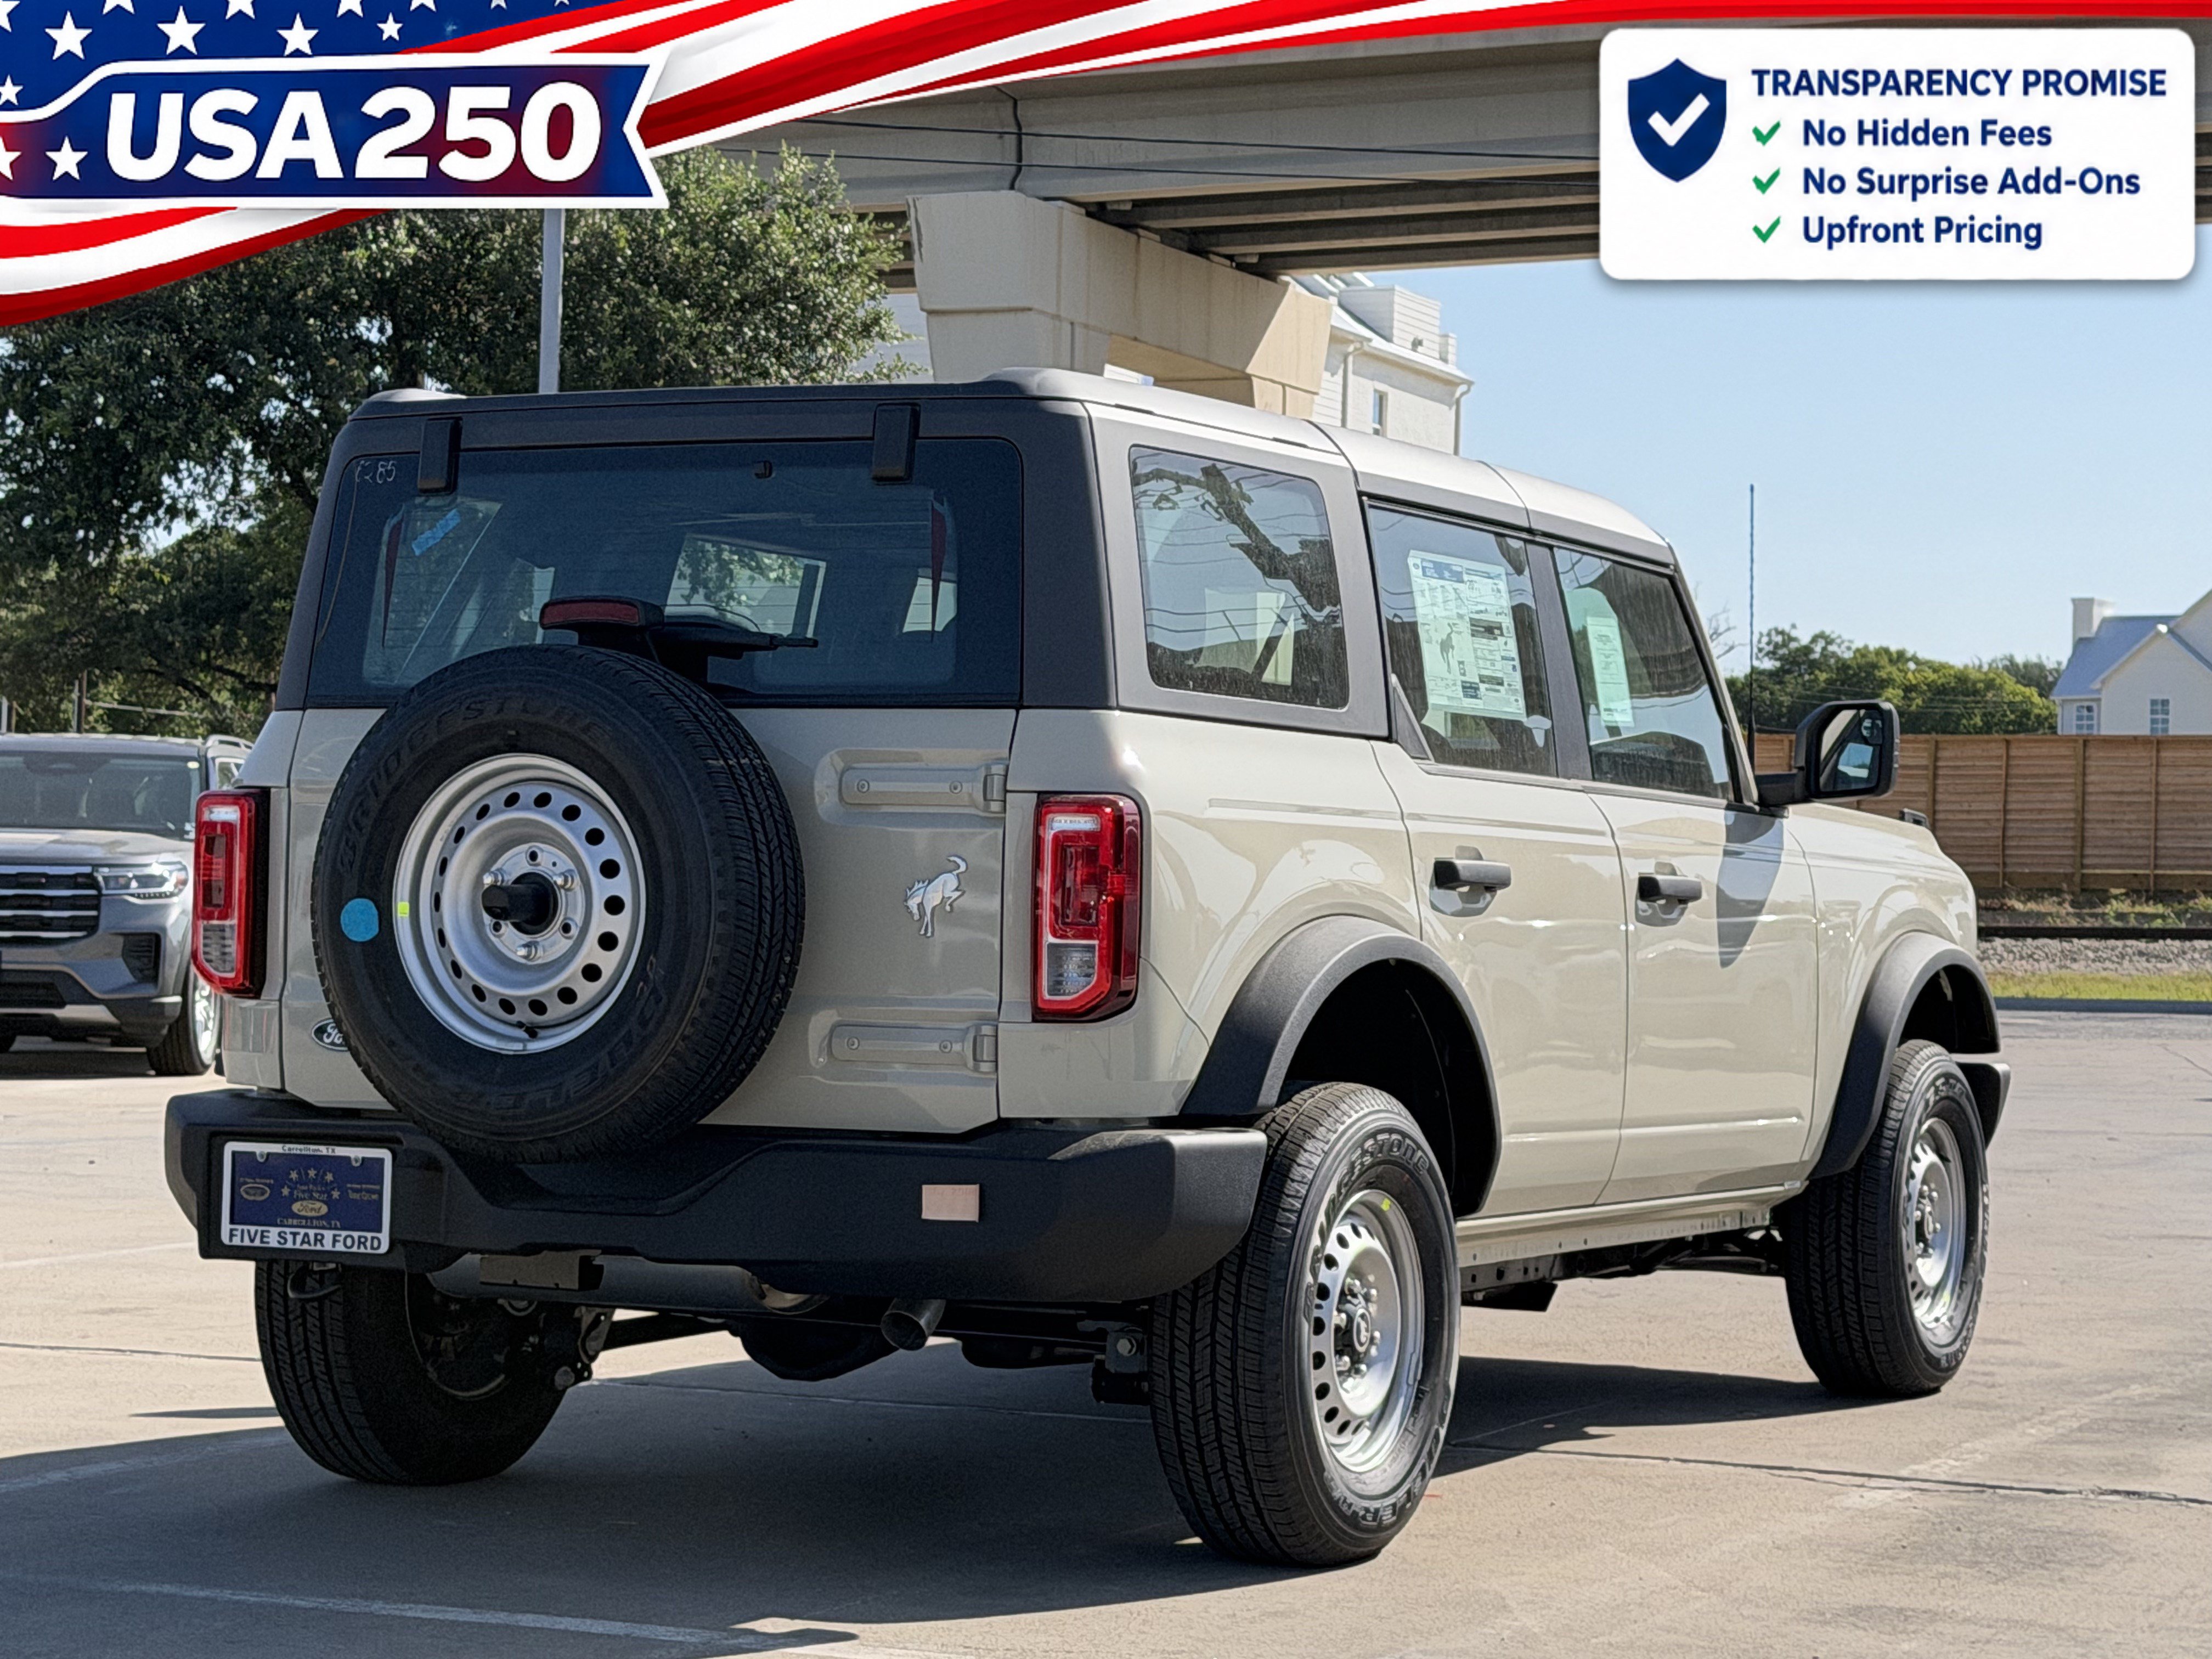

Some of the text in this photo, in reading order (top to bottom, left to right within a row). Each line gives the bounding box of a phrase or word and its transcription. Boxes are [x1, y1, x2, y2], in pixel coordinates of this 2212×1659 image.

[228, 1228, 381, 1251] FIVE STAR FORD
